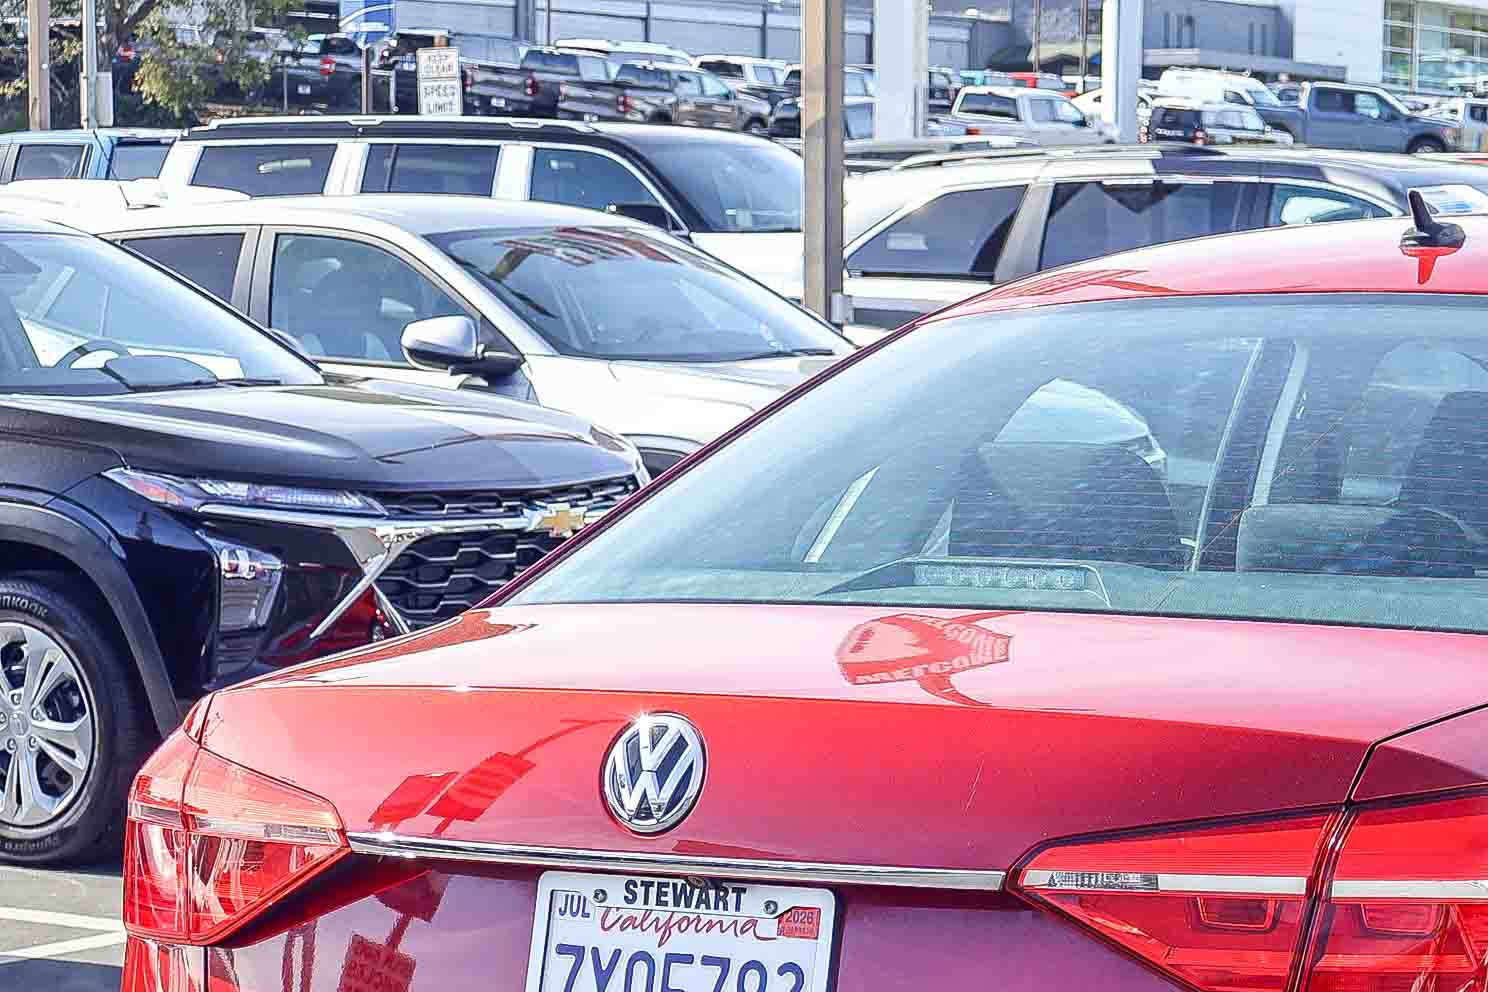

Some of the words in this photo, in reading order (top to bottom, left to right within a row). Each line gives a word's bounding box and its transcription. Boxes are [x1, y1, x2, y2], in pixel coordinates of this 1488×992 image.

[557, 893, 591, 920] JUL
[622, 878, 748, 913] STEWART
[599, 905, 778, 948] California
